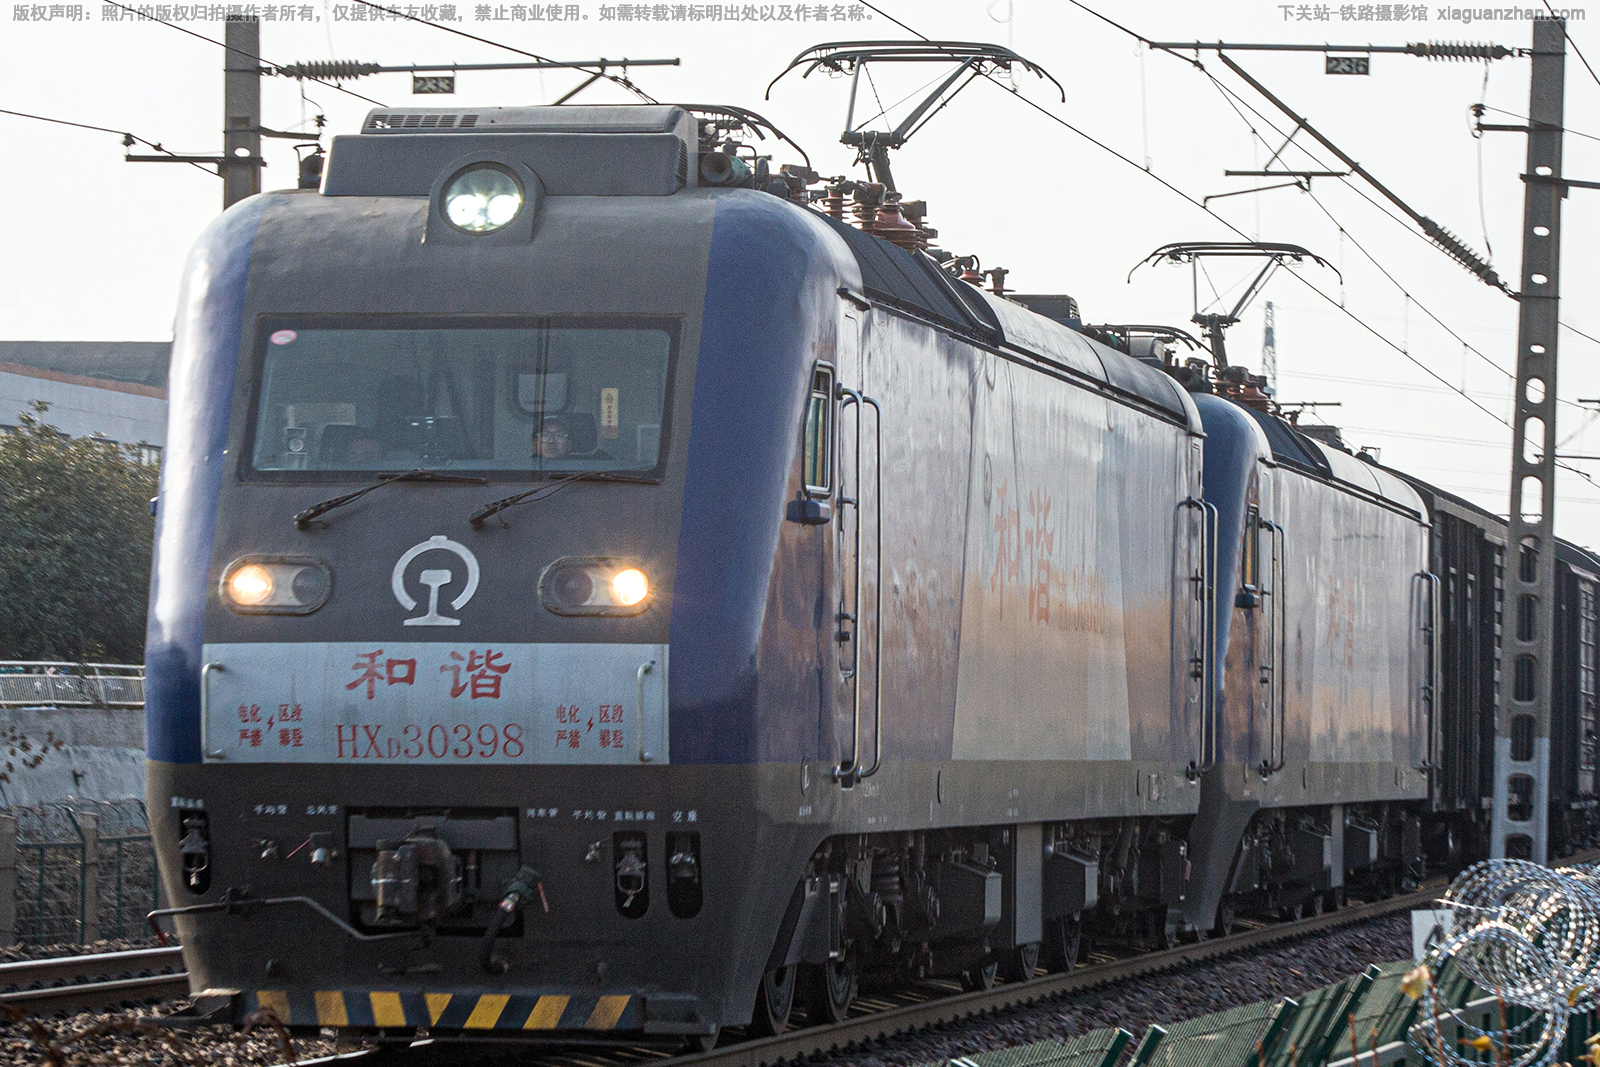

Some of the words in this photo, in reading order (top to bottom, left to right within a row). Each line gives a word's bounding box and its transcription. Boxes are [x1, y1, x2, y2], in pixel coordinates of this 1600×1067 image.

[237, 703, 262, 723] 电化
[556, 704, 580, 723] 电化
[599, 704, 624, 723] 区段
[335, 723, 525, 759] HXD30398
[556, 729, 581, 749] 严禁
